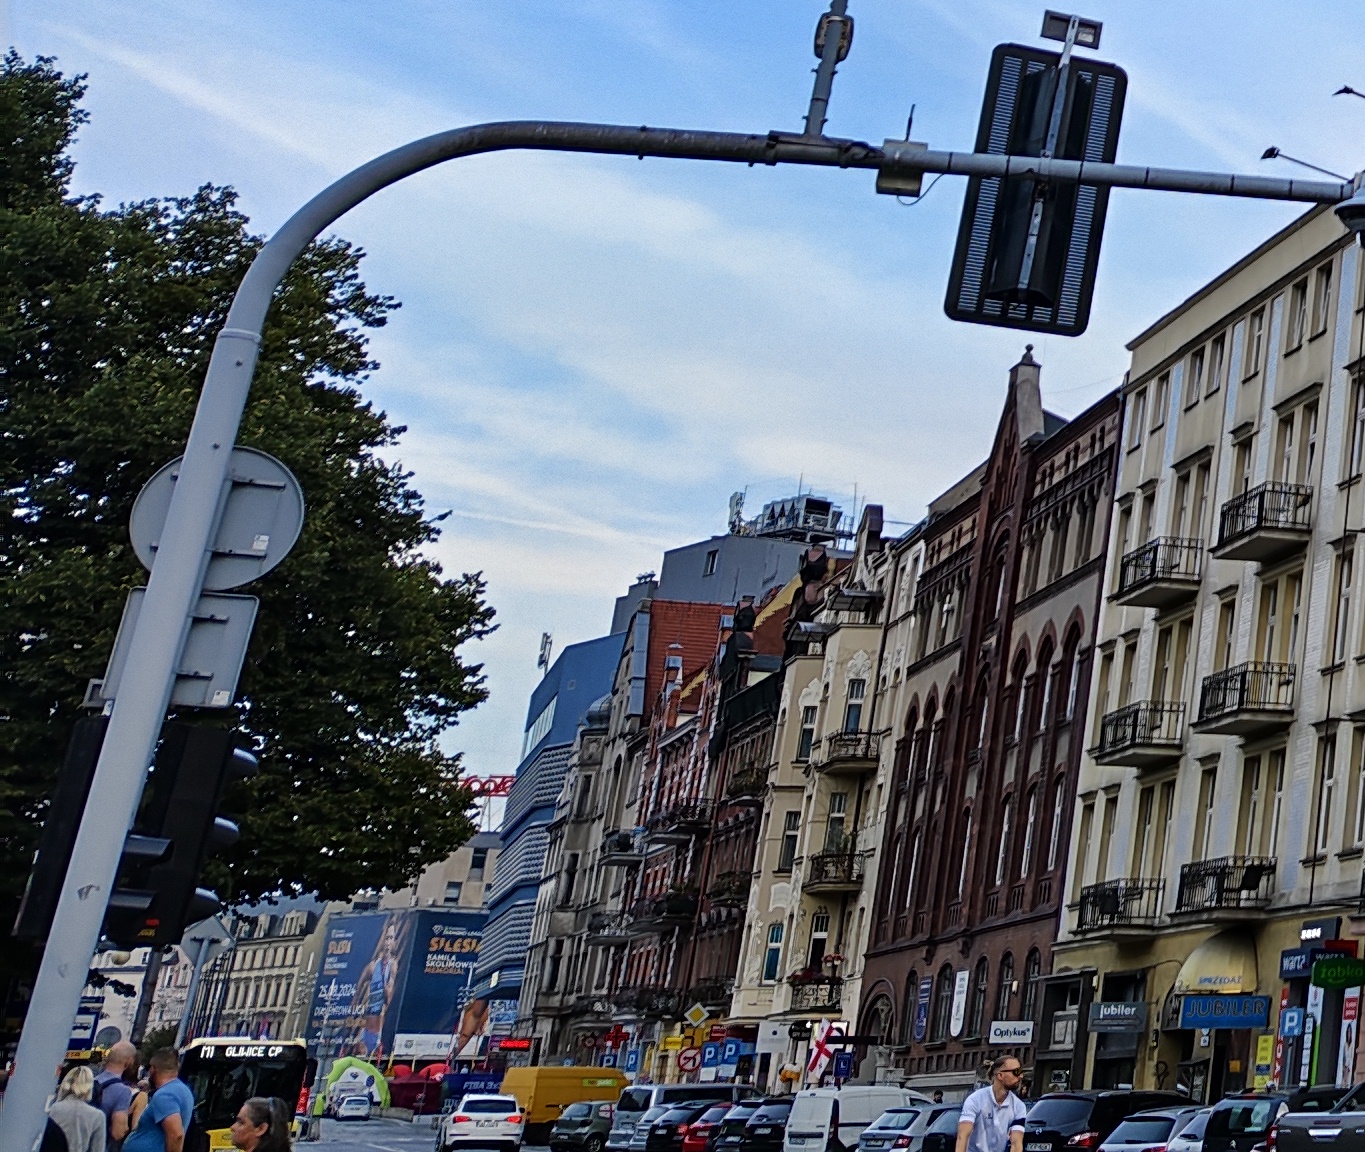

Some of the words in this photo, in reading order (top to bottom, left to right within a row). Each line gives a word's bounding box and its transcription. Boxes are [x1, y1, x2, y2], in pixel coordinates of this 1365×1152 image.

[427, 953, 457, 961] KAMILA
[1100, 1004, 1137, 1019] jubiler
[1186, 999, 1266, 1018] JUBILER
[1285, 1011, 1299, 1033] P
[225, 1046, 264, 1057] GLIWICE
[268, 1046, 283, 1057] CP
[705, 1047, 715, 1062] P
[724, 1043, 736, 1059] P
[628, 1055, 635, 1068] P
[463, 1080, 485, 1090] FIBA
